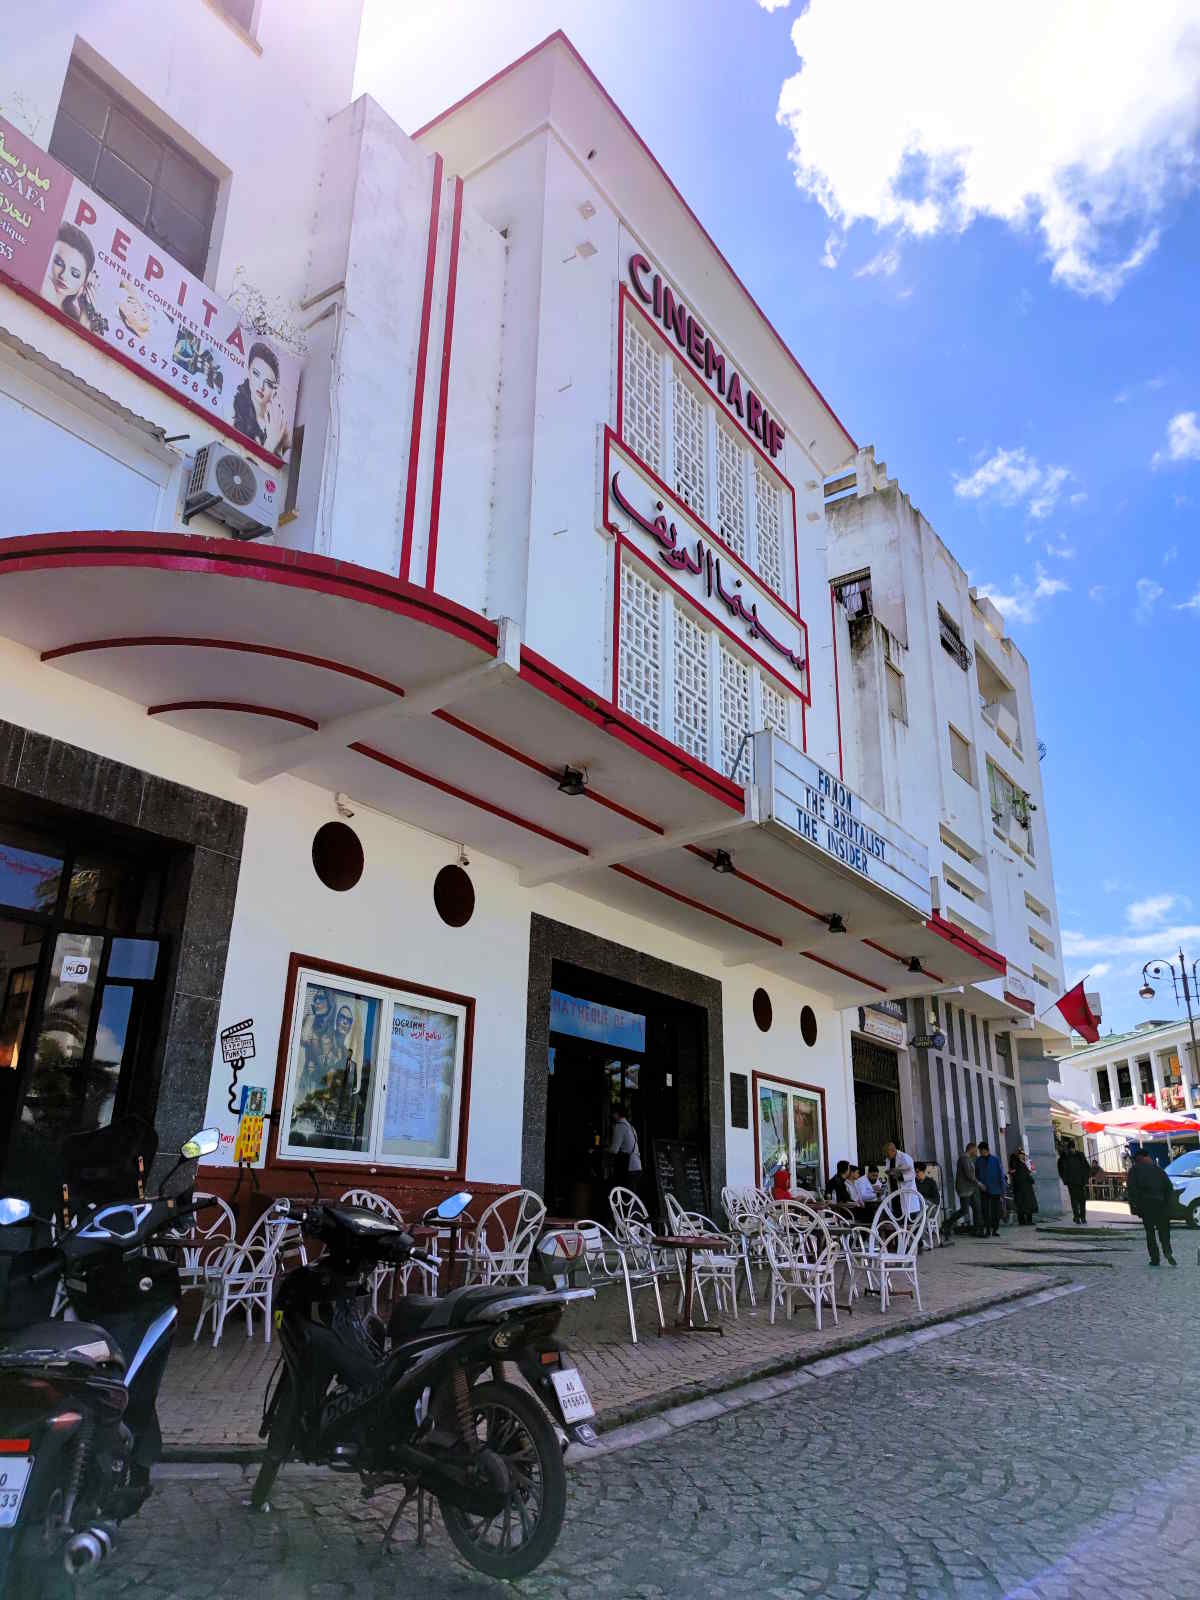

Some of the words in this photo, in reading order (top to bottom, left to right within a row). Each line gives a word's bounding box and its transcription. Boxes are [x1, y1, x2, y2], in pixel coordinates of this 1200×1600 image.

[75, 199, 245, 355] PEPITA
[98, 251, 132, 282] CENTRE
[134, 278, 145, 293] DE
[147, 289, 188, 324] COIFFURE
[189, 320, 198, 332] ET
[115, 328, 219, 406] 0665795896
[805, 787, 825, 819] THE
[833, 807, 886, 860] BRUTALIST
[818, 767, 852, 813] FANON
[796, 808, 818, 842] THE
[827, 831, 869, 874] INSIDER
